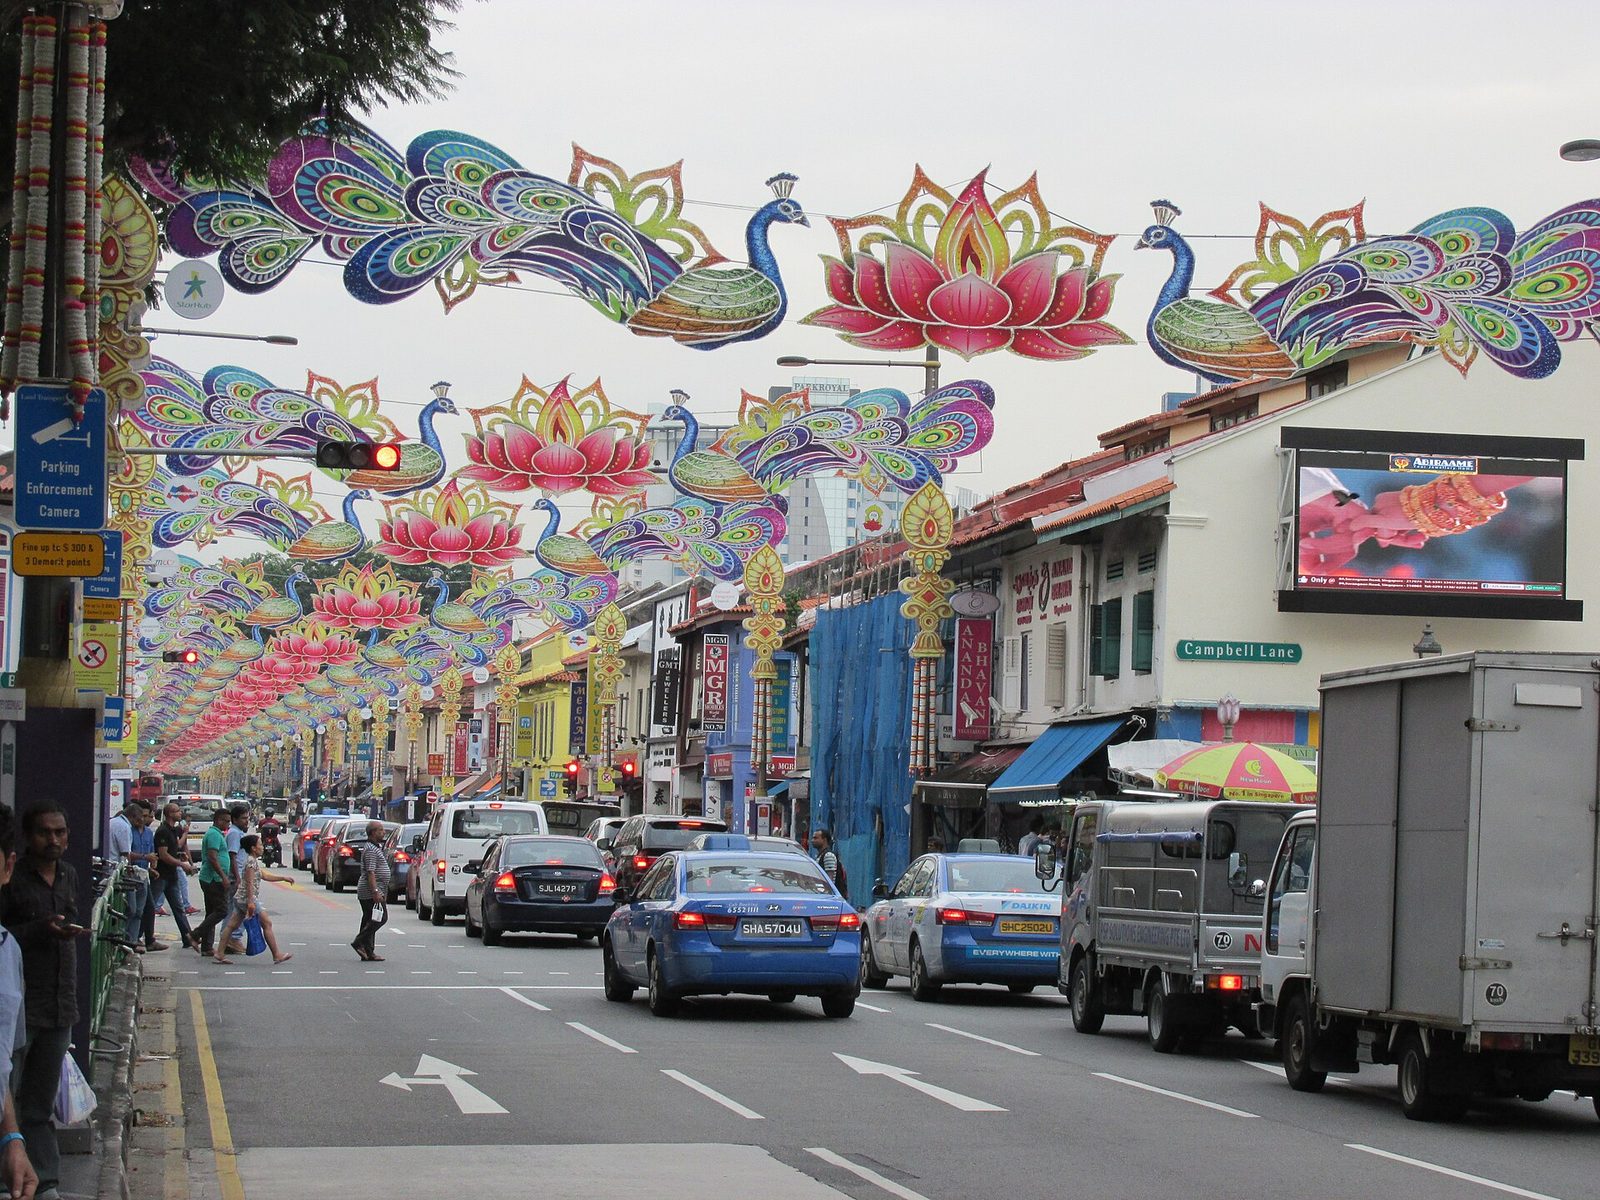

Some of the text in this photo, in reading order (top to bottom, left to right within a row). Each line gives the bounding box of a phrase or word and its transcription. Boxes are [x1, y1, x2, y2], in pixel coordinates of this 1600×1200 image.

[176, 301, 212, 309] StarHub
[40, 460, 80, 476] Parking
[1413, 457, 1474, 468] ABIRAAME
[26, 482, 94, 496] Enforcement
[39, 504, 80, 518] Camera
[22, 542, 38, 552] Fine
[40, 545, 49, 553] up
[62, 543, 69, 552] $
[71, 544, 86, 552] 300
[88, 544, 94, 552] &
[25, 557, 91, 568] 3 Demerit points
[1310, 576, 1328, 584] Only
[706, 636, 727, 644] MGM
[1184, 642, 1294, 658] Campbell Lane
[658, 660, 680, 670] GMT
[960, 624, 988, 720] ANANDA BHAVAN
[706, 660, 726, 705] MGR
[662, 670, 671, 723] JEWELLERS
[1241, 789, 1246, 797] 1
[1011, 902, 1052, 911] DAIKIN
[742, 924, 802, 934] SHA5704U
[1001, 922, 1053, 933] SHC2502U
[1216, 934, 1230, 945] 70
[972, 949, 1040, 957] EVERYWHERE
[1490, 986, 1504, 997] 70
